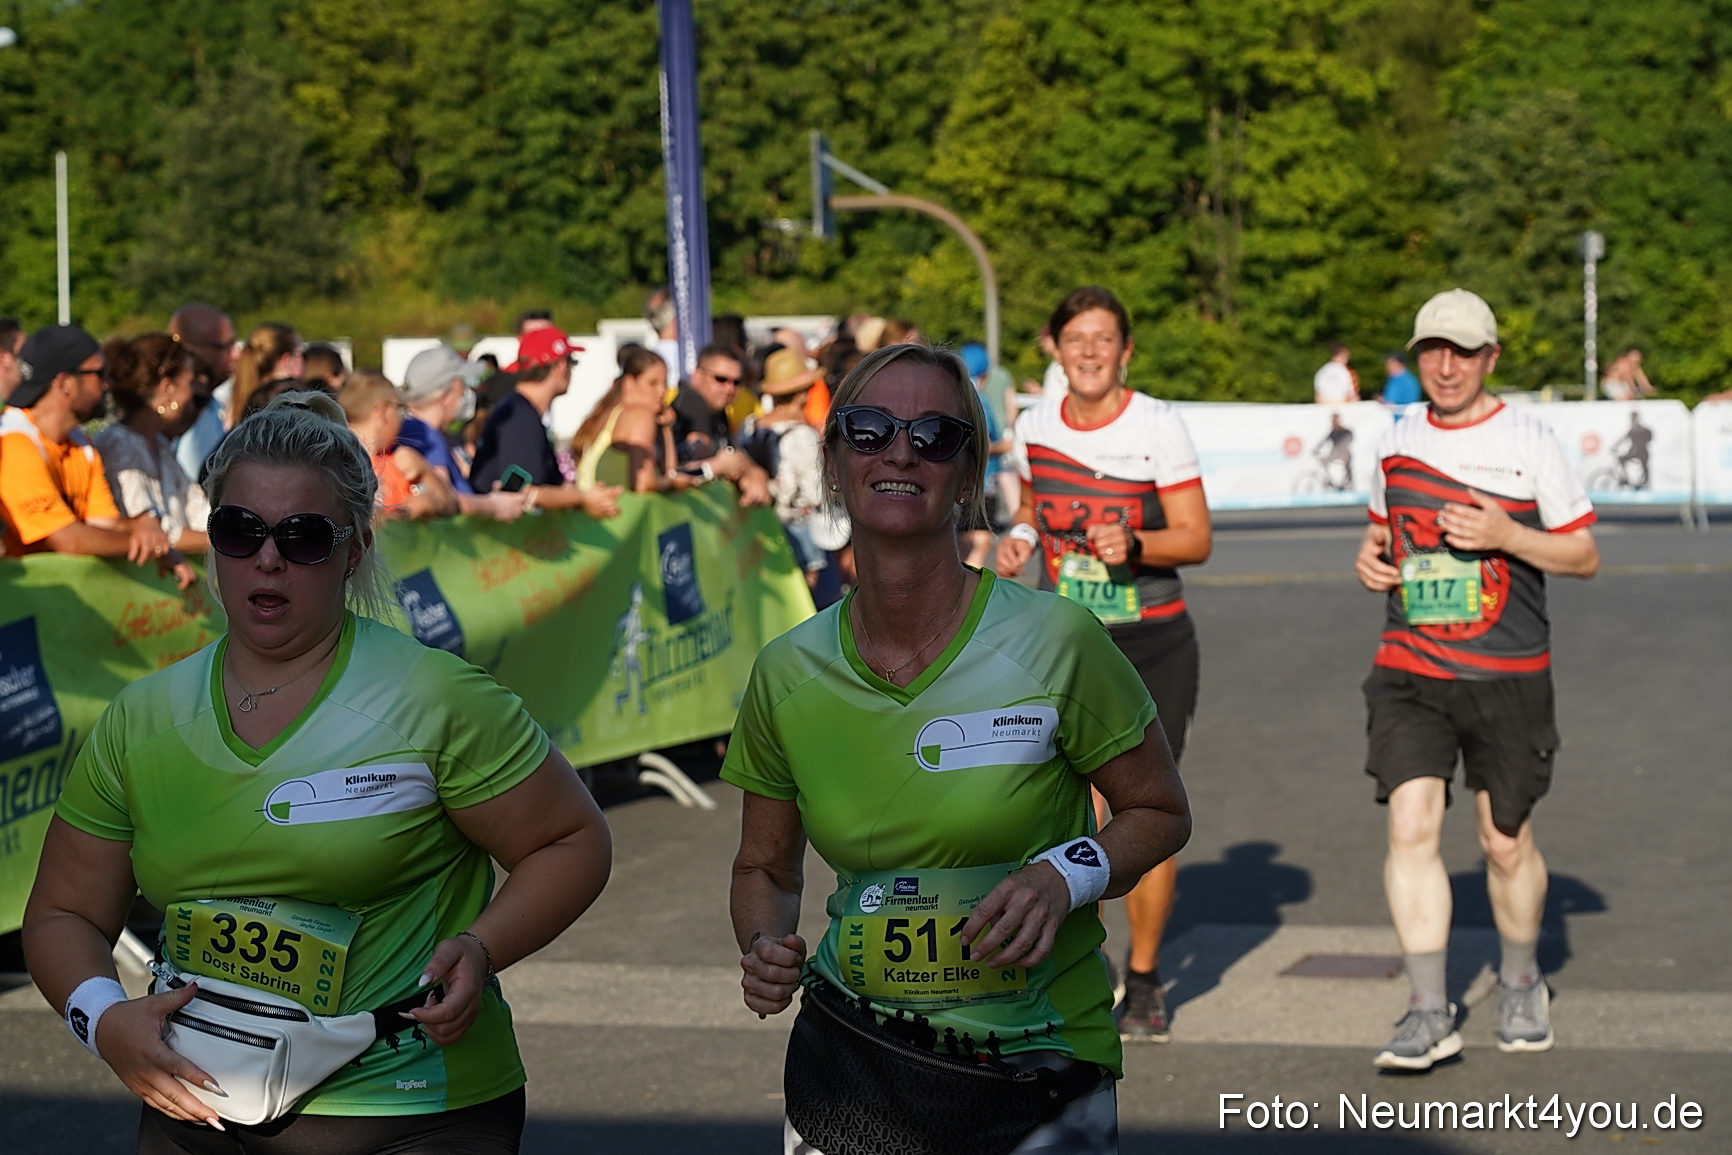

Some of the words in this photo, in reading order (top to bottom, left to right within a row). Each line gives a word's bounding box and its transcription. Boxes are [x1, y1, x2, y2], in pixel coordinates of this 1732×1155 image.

[1076, 580, 1116, 599] 170
[1416, 579, 1456, 599] 117
[993, 715, 1043, 727] Klinikum
[991, 728, 1041, 738] Neumarkt
[345, 773, 396, 785] Klinikum
[345, 782, 394, 794] Neumarkt
[884, 894, 939, 906] Firmenlauf
[905, 904, 939, 912] neumarkt
[239, 905, 273, 917] neumarkt
[176, 907, 193, 962] WALK
[209, 912, 302, 973] 335
[883, 917, 971, 962] 511
[849, 922, 867, 987] WALK
[202, 950, 236, 975] Dost
[239, 965, 301, 996] Sabrina
[314, 949, 337, 1007] 2022
[883, 968, 938, 983] Katzer
[943, 966, 981, 982] Elke
